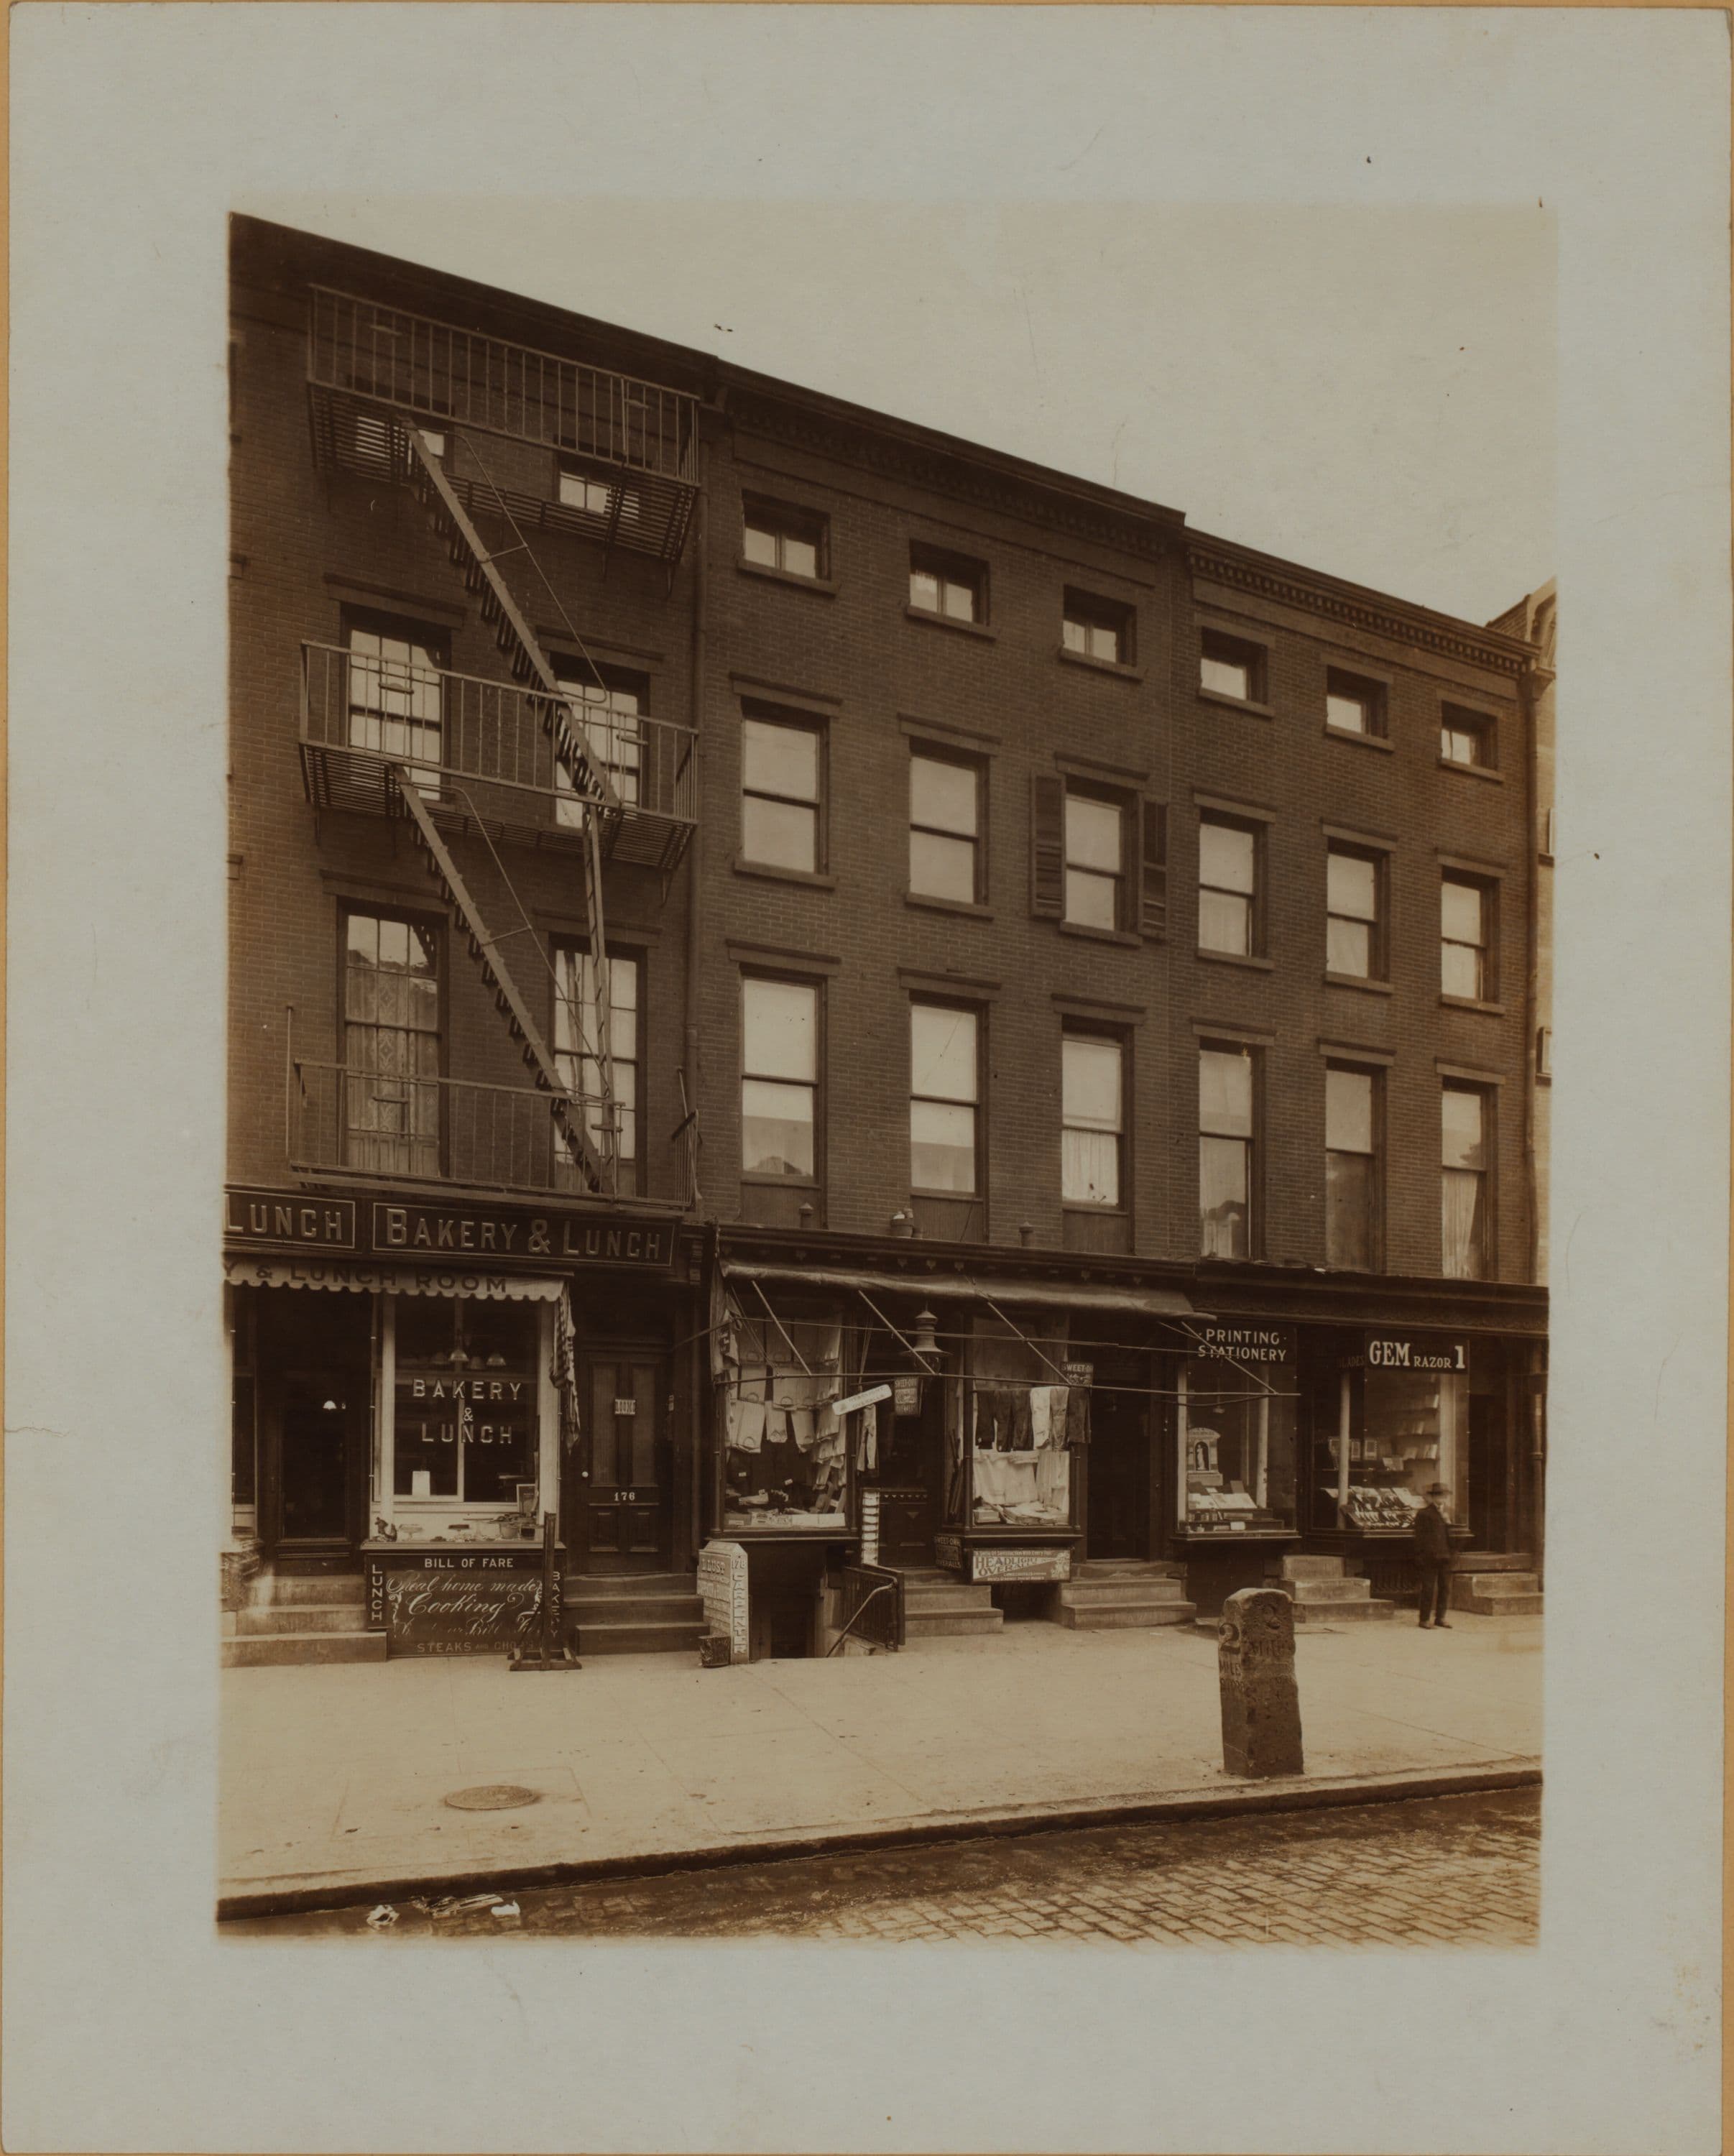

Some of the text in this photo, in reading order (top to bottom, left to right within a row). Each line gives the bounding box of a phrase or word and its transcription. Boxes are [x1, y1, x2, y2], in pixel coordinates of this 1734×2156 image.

[224, 1194, 343, 1240] LUNCH
[387, 1208, 660, 1260] BAKERY & LUNCH
[257, 1265, 272, 1279] &
[290, 1264, 397, 1286] LUNCH
[416, 1271, 506, 1293] ROOM
[1206, 1328, 1280, 1345] PRINTING
[1198, 1345, 1286, 1362] STATIONERY
[1369, 1340, 1465, 1368] GEM RAZOR 1
[412, 1378, 522, 1400] BAKERY
[464, 1407, 474, 1422] &
[422, 1423, 512, 1444] LUNCH
[614, 1492, 635, 1501] 176
[425, 1558, 514, 1568] BILL OF FARE
[372, 1564, 383, 1621] LUNCH
[441, 1573, 484, 1592] home
[490, 1578, 538, 1592] made
[550, 1571, 561, 1638] BAKERY
[417, 1642, 471, 1652] STEAKS
[1219, 1623, 1241, 1654] 2
